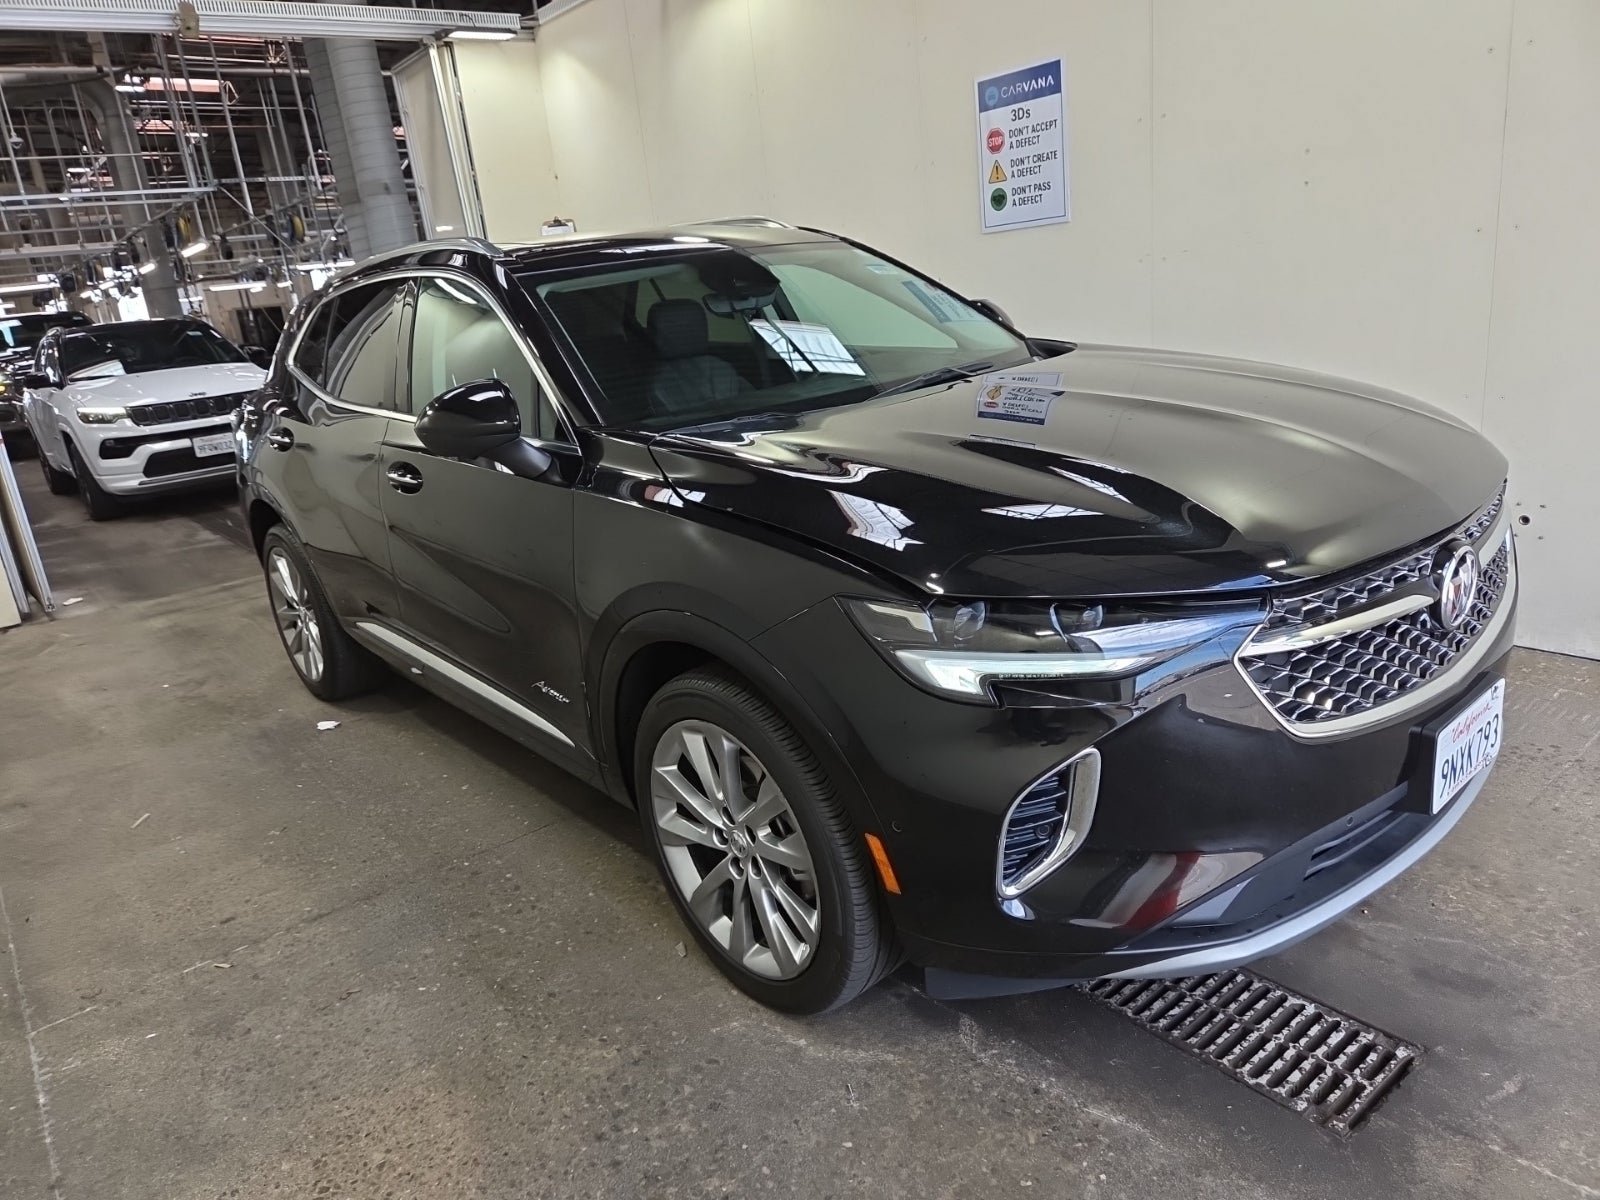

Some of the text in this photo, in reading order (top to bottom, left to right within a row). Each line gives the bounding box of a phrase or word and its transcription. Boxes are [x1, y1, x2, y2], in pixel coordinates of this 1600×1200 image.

[1001, 75, 1054, 98] CARVANA
[1009, 119, 1058, 139] DON'T ACCEPT
[988, 135, 1003, 148] STOP
[1009, 134, 1041, 151] A DEFECT
[1010, 150, 1058, 168] DON'T CREATE
[1011, 165, 1042, 179] A DEFECT
[1011, 181, 1052, 197] DON'T PASS
[1012, 194, 1043, 208] A DEFECT
[1451, 702, 1493, 743] California
[1439, 713, 1499, 799] 9NXK793
